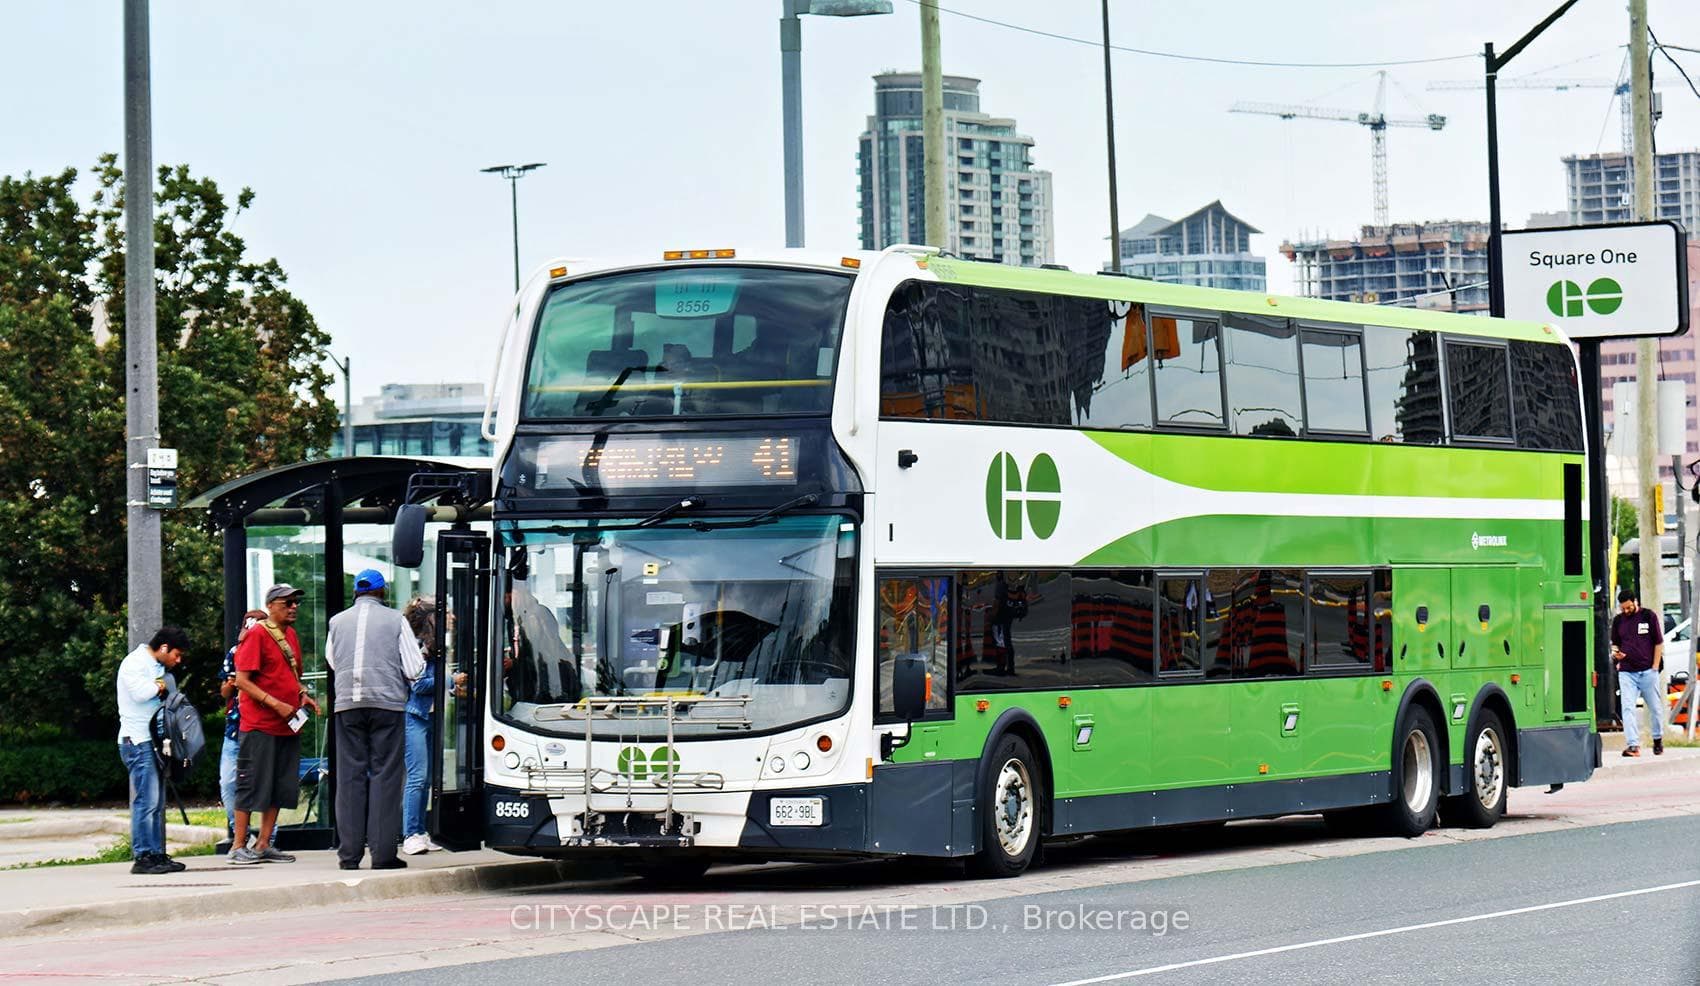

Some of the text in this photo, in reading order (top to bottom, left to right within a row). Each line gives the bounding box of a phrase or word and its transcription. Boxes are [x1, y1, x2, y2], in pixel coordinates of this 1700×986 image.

[1529, 248, 1637, 269] Square One
[675, 299, 711, 314] 8556
[1546, 277, 1623, 317] GO
[751, 438, 794, 476] 41
[985, 450, 1062, 540] GO
[495, 801, 530, 818] 8556
